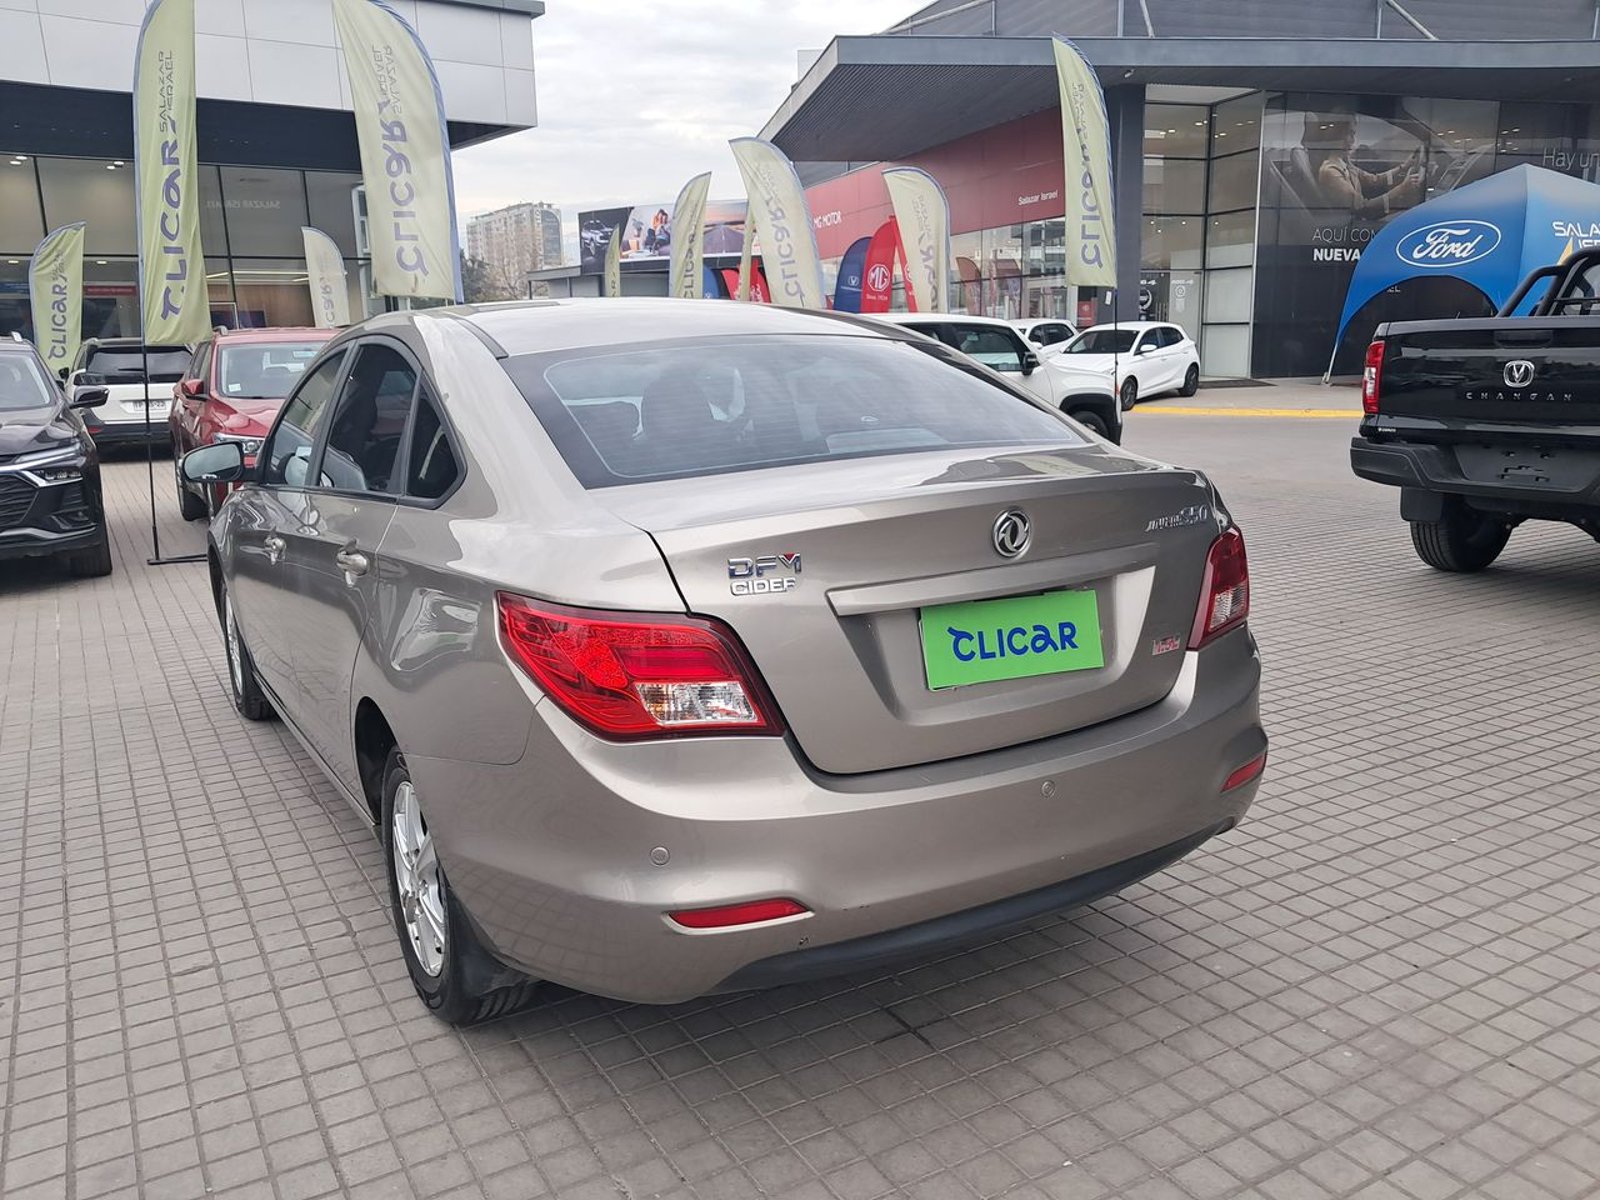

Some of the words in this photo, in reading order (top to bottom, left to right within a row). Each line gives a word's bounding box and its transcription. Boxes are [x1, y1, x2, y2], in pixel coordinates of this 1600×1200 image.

[158, 51, 168, 132] SALAZAR
[1542, 146, 1576, 170] Hay
[1312, 226, 1347, 244] AQUÍ
[1552, 221, 1600, 238] SALA
[1412, 228, 1484, 260] Ford
[868, 264, 891, 292] MG
[1465, 391, 1572, 401] CHANGAN
[728, 551, 802, 579] DFM
[730, 577, 796, 596] CIDEF
